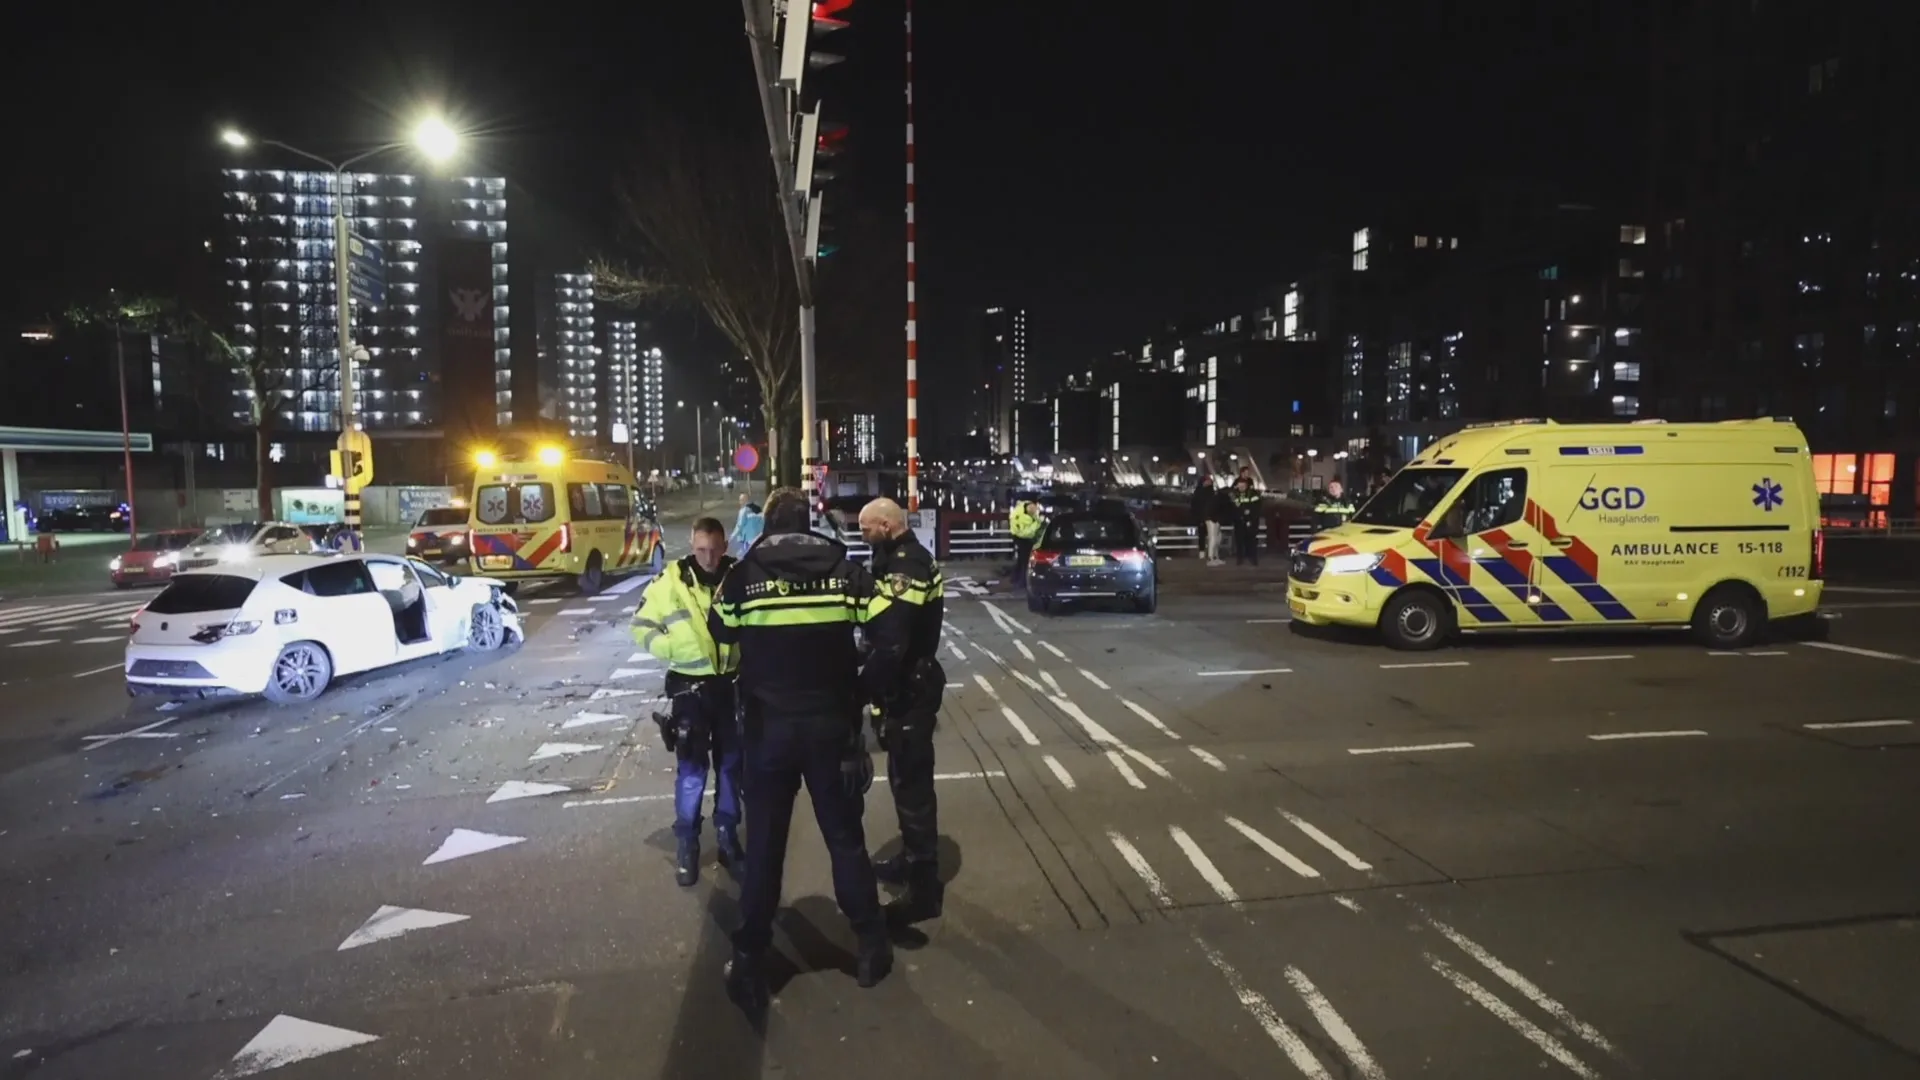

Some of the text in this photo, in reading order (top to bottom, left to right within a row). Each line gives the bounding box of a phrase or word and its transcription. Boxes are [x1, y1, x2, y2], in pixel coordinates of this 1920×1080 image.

[1580, 486, 1645, 510] GGD
[1599, 513, 1659, 526] Haaglanden
[1611, 541, 1783, 556] AMBULANCE 15-118
[1785, 566, 1805, 577] 112
[765, 578, 836, 596] POLITIE
